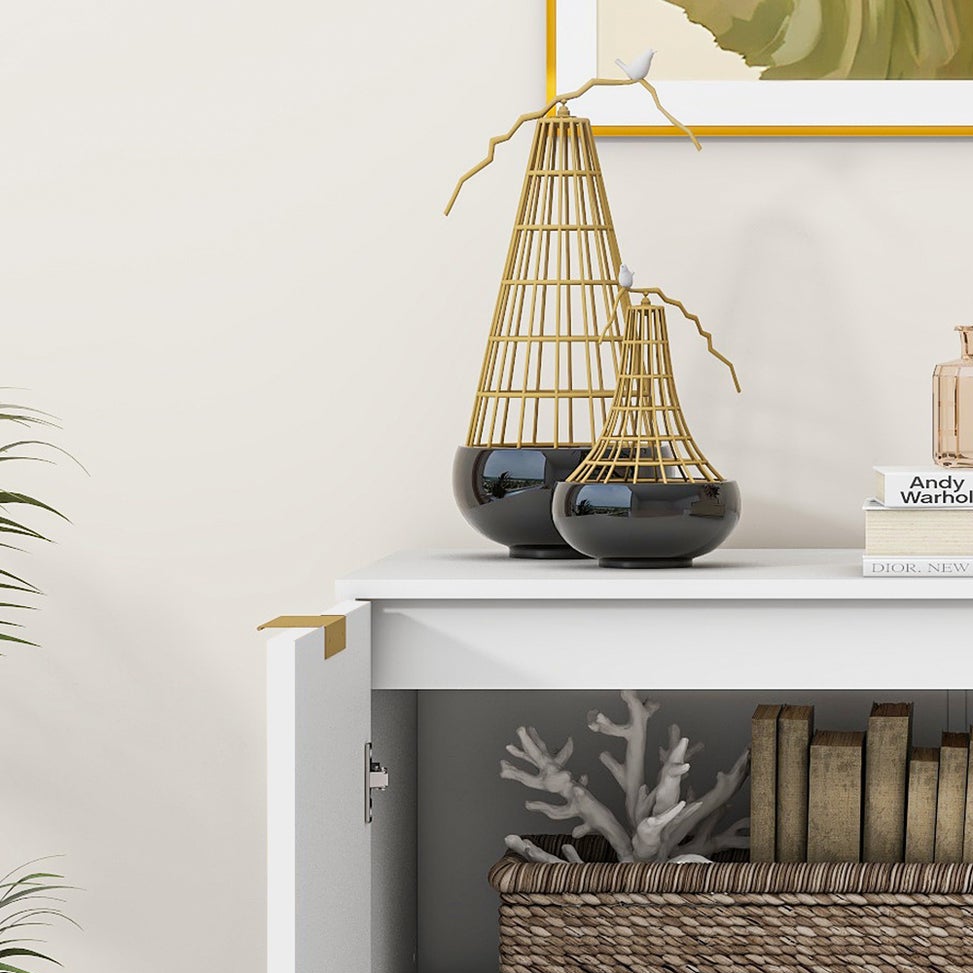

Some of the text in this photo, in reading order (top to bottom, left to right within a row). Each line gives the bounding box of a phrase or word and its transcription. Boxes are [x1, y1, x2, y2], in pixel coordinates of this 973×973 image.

[909, 475, 965, 493] Andy
[900, 490, 973, 504] Warhol
[872, 562, 921, 574] DIOR.
[928, 562, 970, 574] NEW
